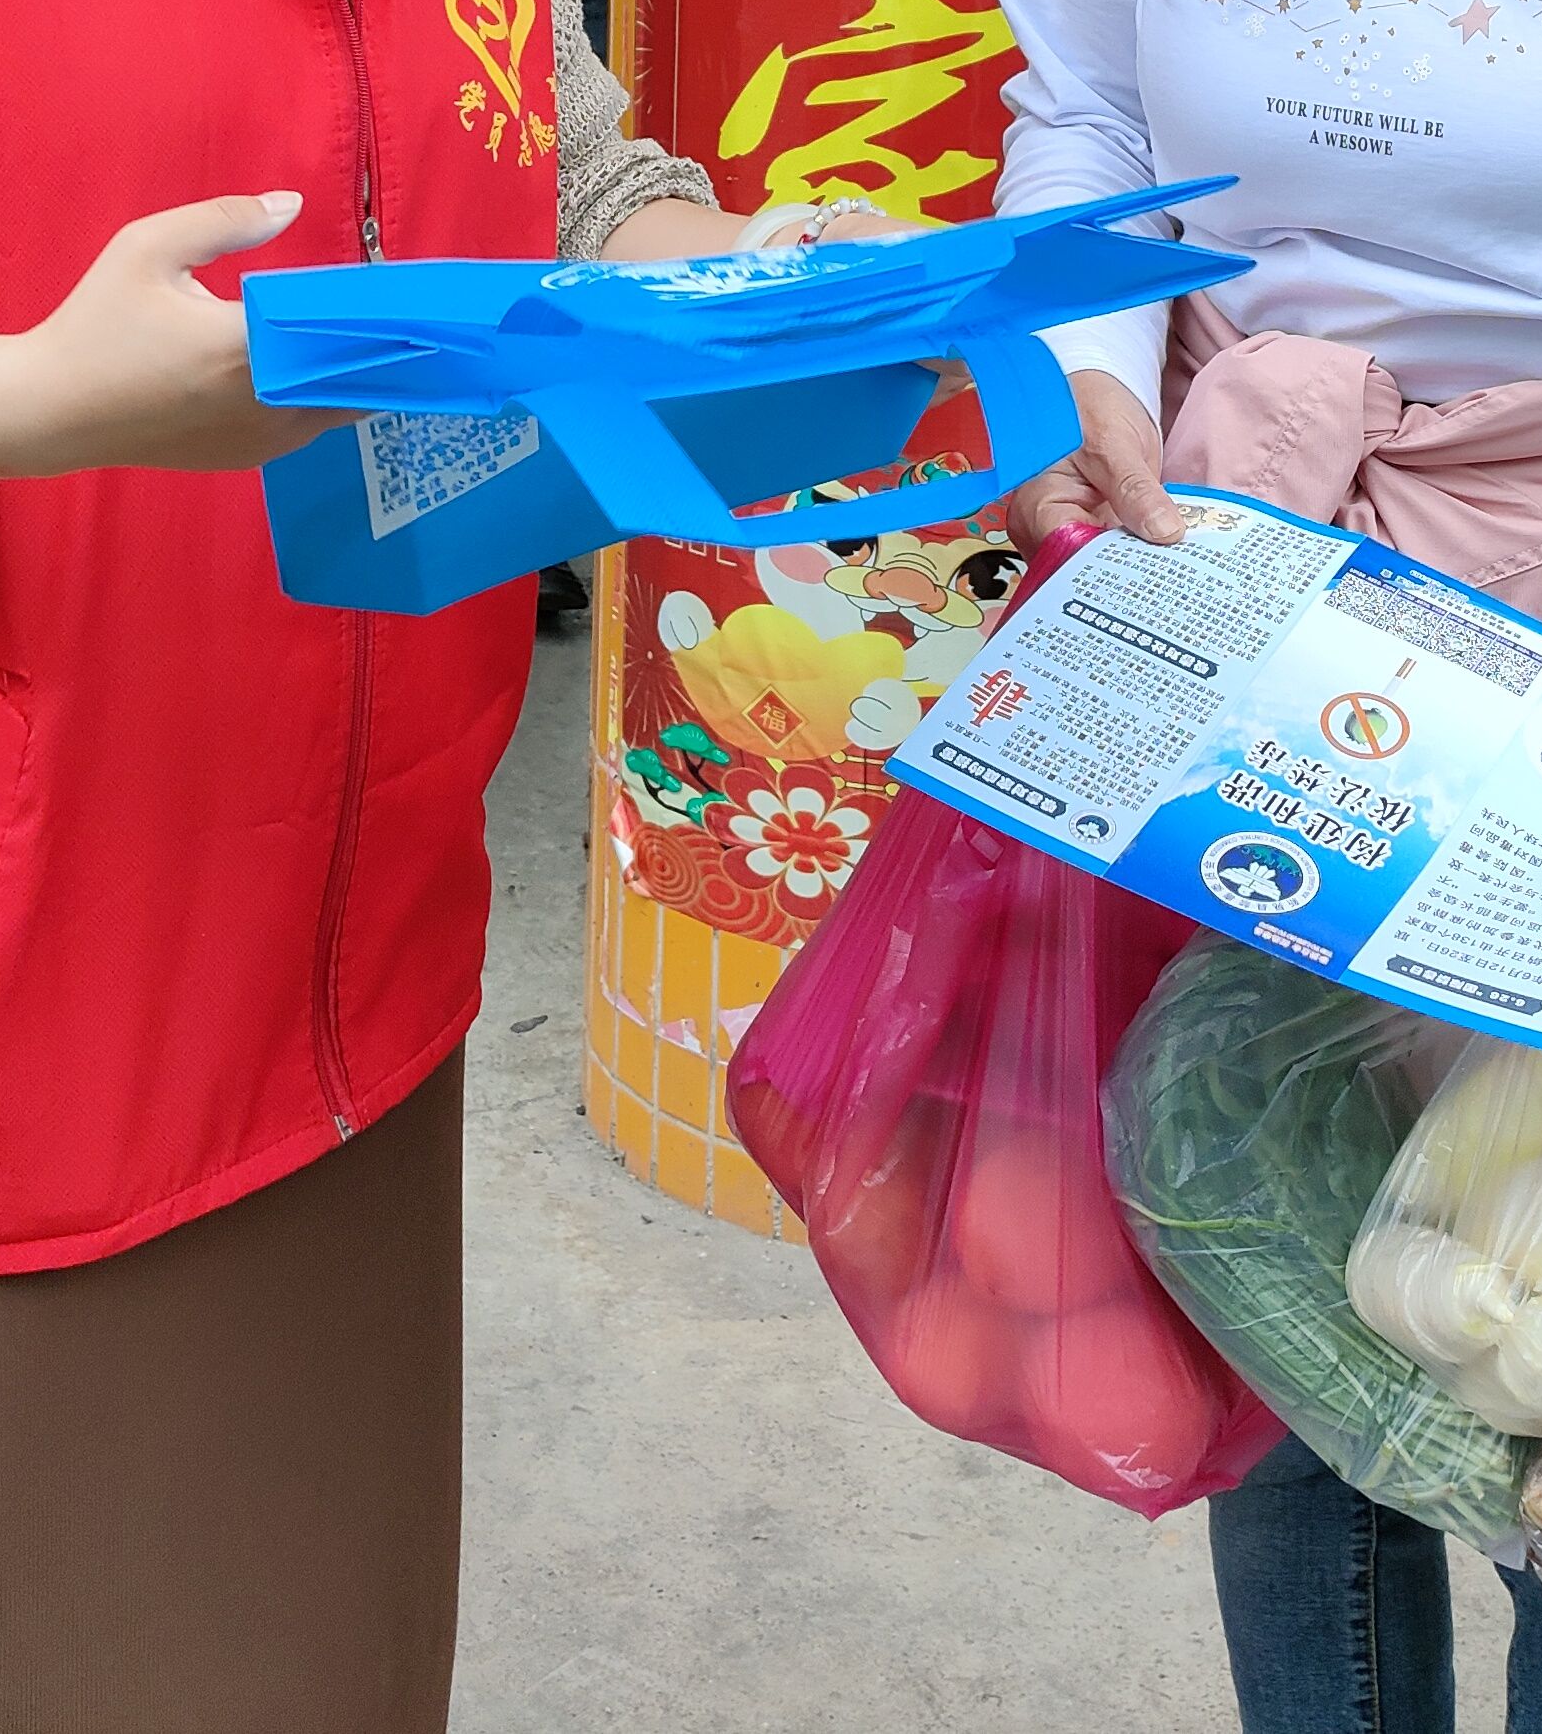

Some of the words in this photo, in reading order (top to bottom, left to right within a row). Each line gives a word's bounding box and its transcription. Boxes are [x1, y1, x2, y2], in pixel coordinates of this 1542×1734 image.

[1265, 96, 1308, 118] YOUR
[1311, 101, 1374, 129] FUTURE
[1378, 111, 1420, 135] WILL
[1423, 119, 1445, 139] BE
[1309, 129, 1320, 145] A
[1324, 131, 1394, 156] WESOWE
[759, 702, 788, 734] 福
[1242, 735, 1417, 835] 依法禁毒
[1215, 769, 1393, 870] 构建和谐
